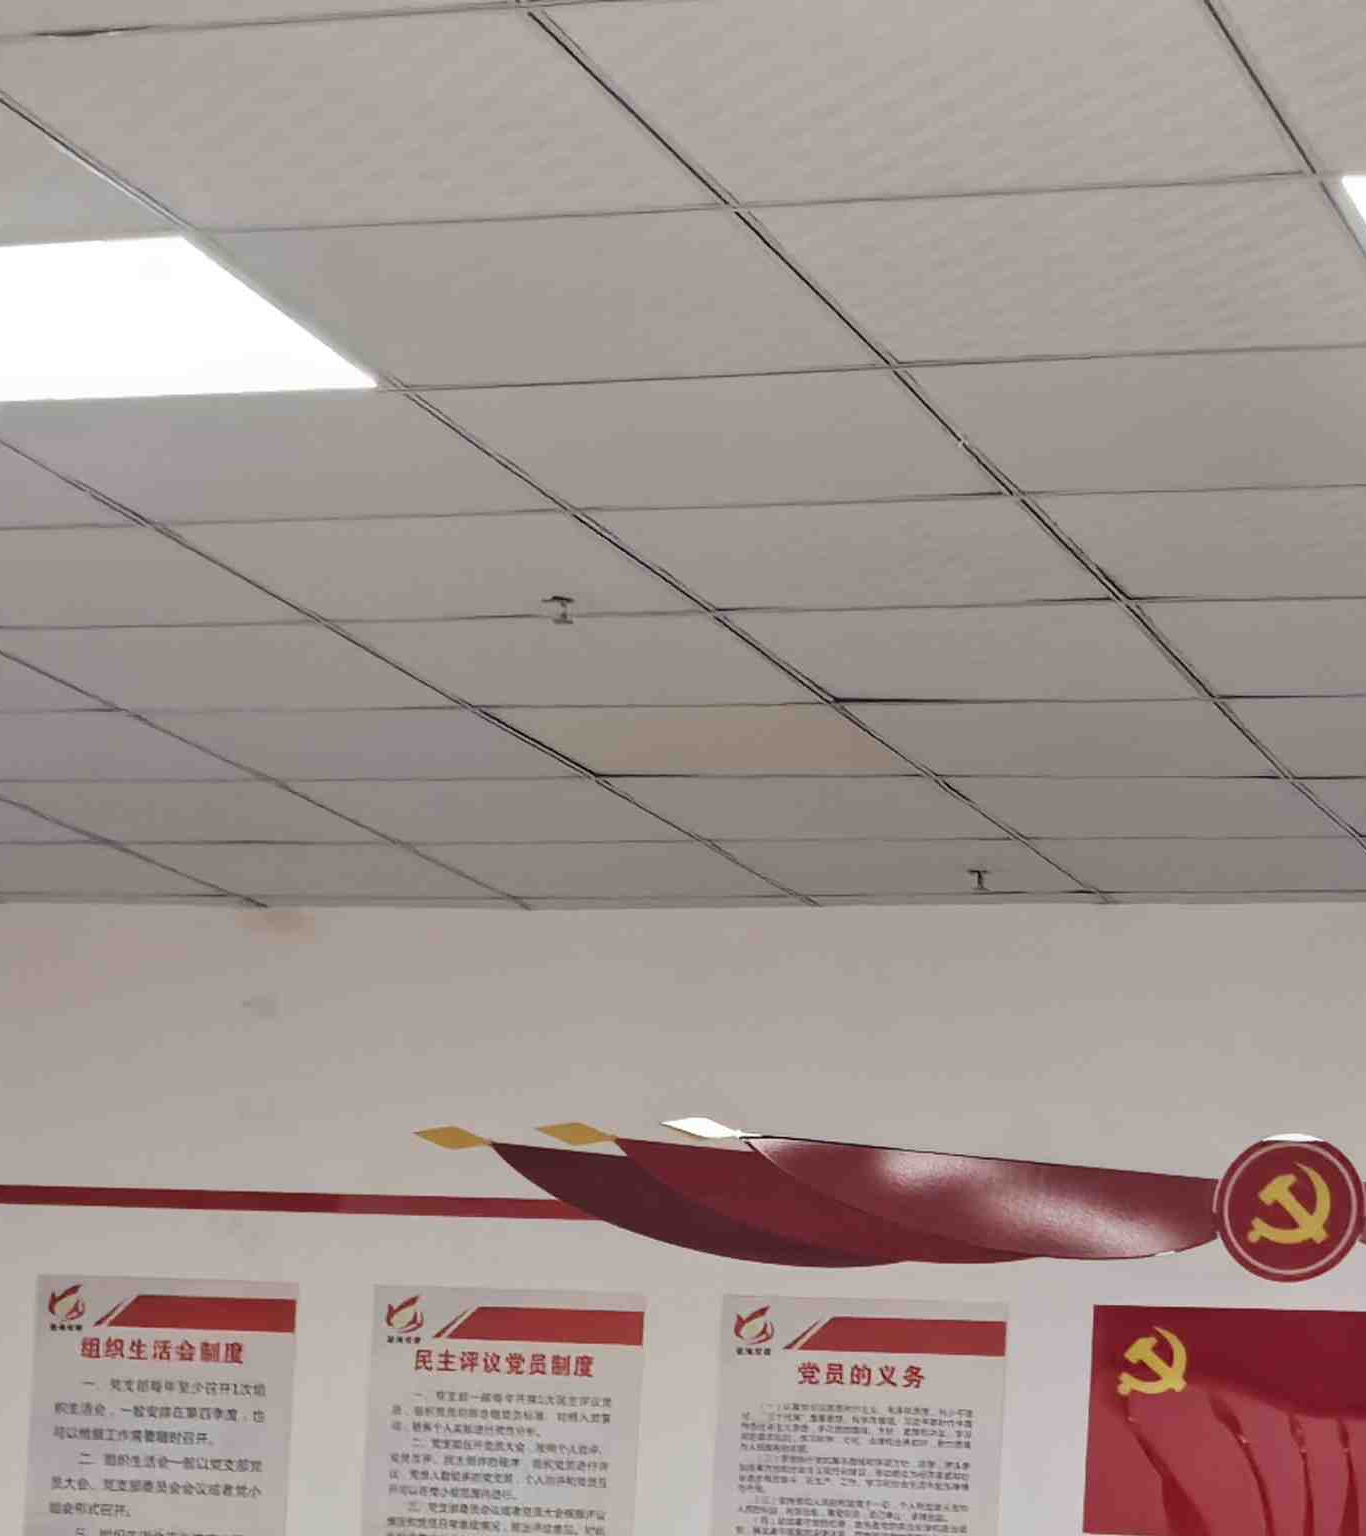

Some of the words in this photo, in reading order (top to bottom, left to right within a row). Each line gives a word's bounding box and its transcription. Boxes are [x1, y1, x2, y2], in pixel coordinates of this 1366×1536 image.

[81, 1336, 243, 1364] 组织生活会制度
[415, 1349, 594, 1377] 民主评议党员制度
[798, 1361, 924, 1388] 党员的义务
